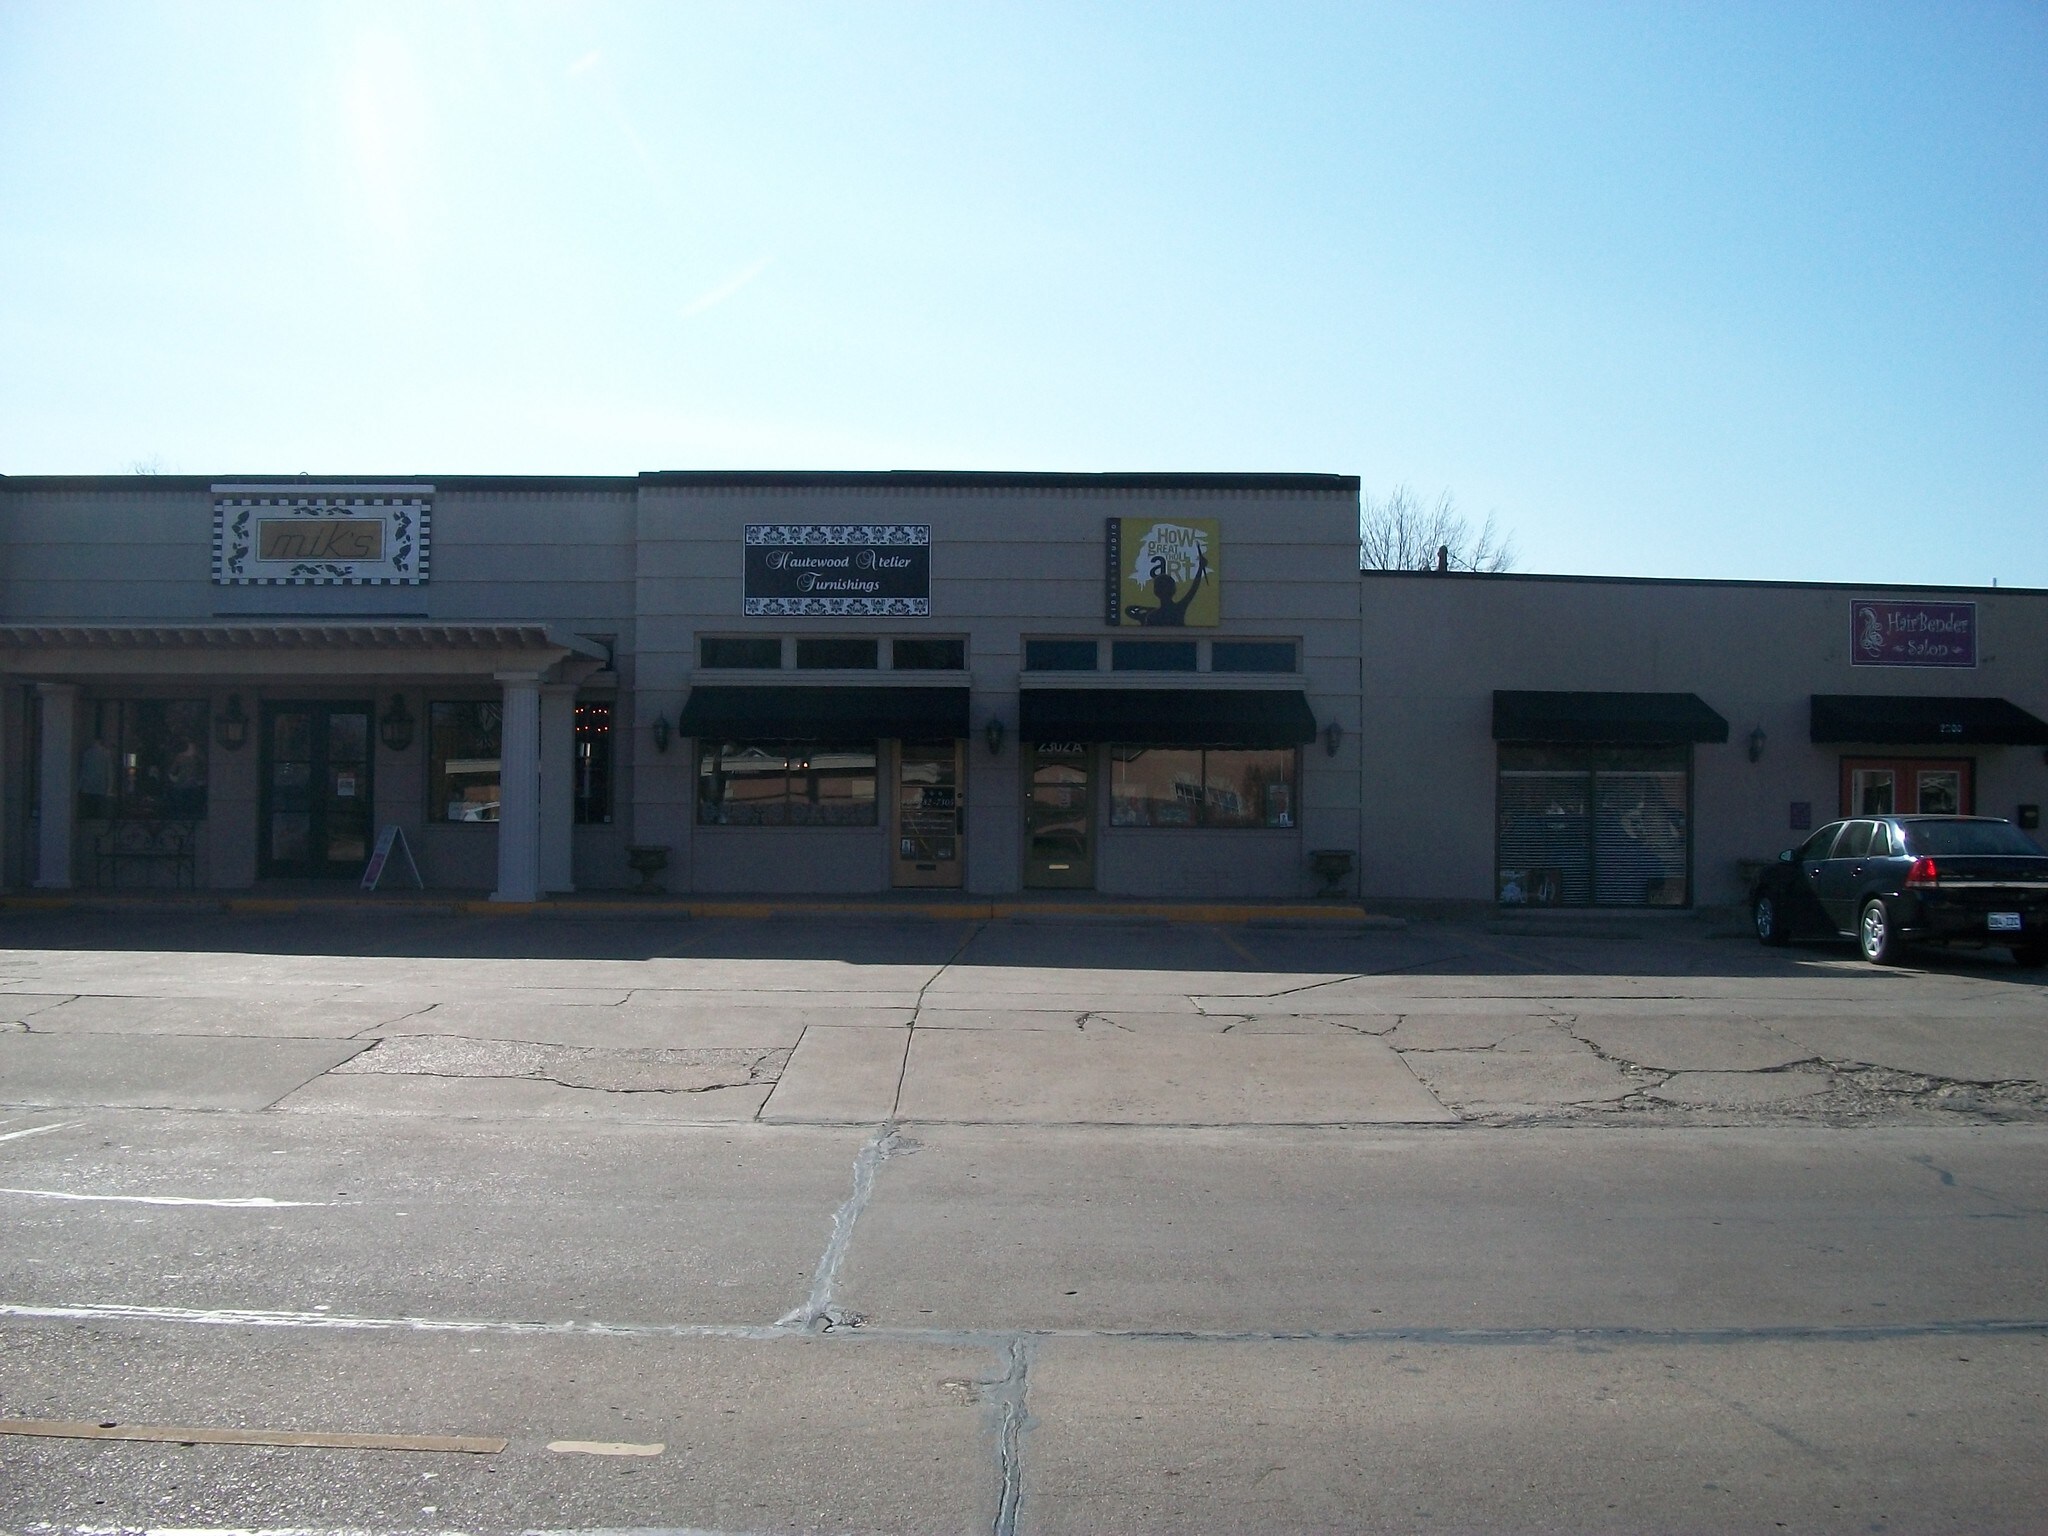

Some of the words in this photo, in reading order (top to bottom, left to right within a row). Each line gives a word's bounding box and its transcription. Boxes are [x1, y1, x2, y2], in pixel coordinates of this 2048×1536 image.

[765, 549, 850, 571] Hautewood
[855, 548, 912, 571] Atelier
[797, 571, 880, 593] Furnishings
[1908, 639, 1949, 657] Salon
